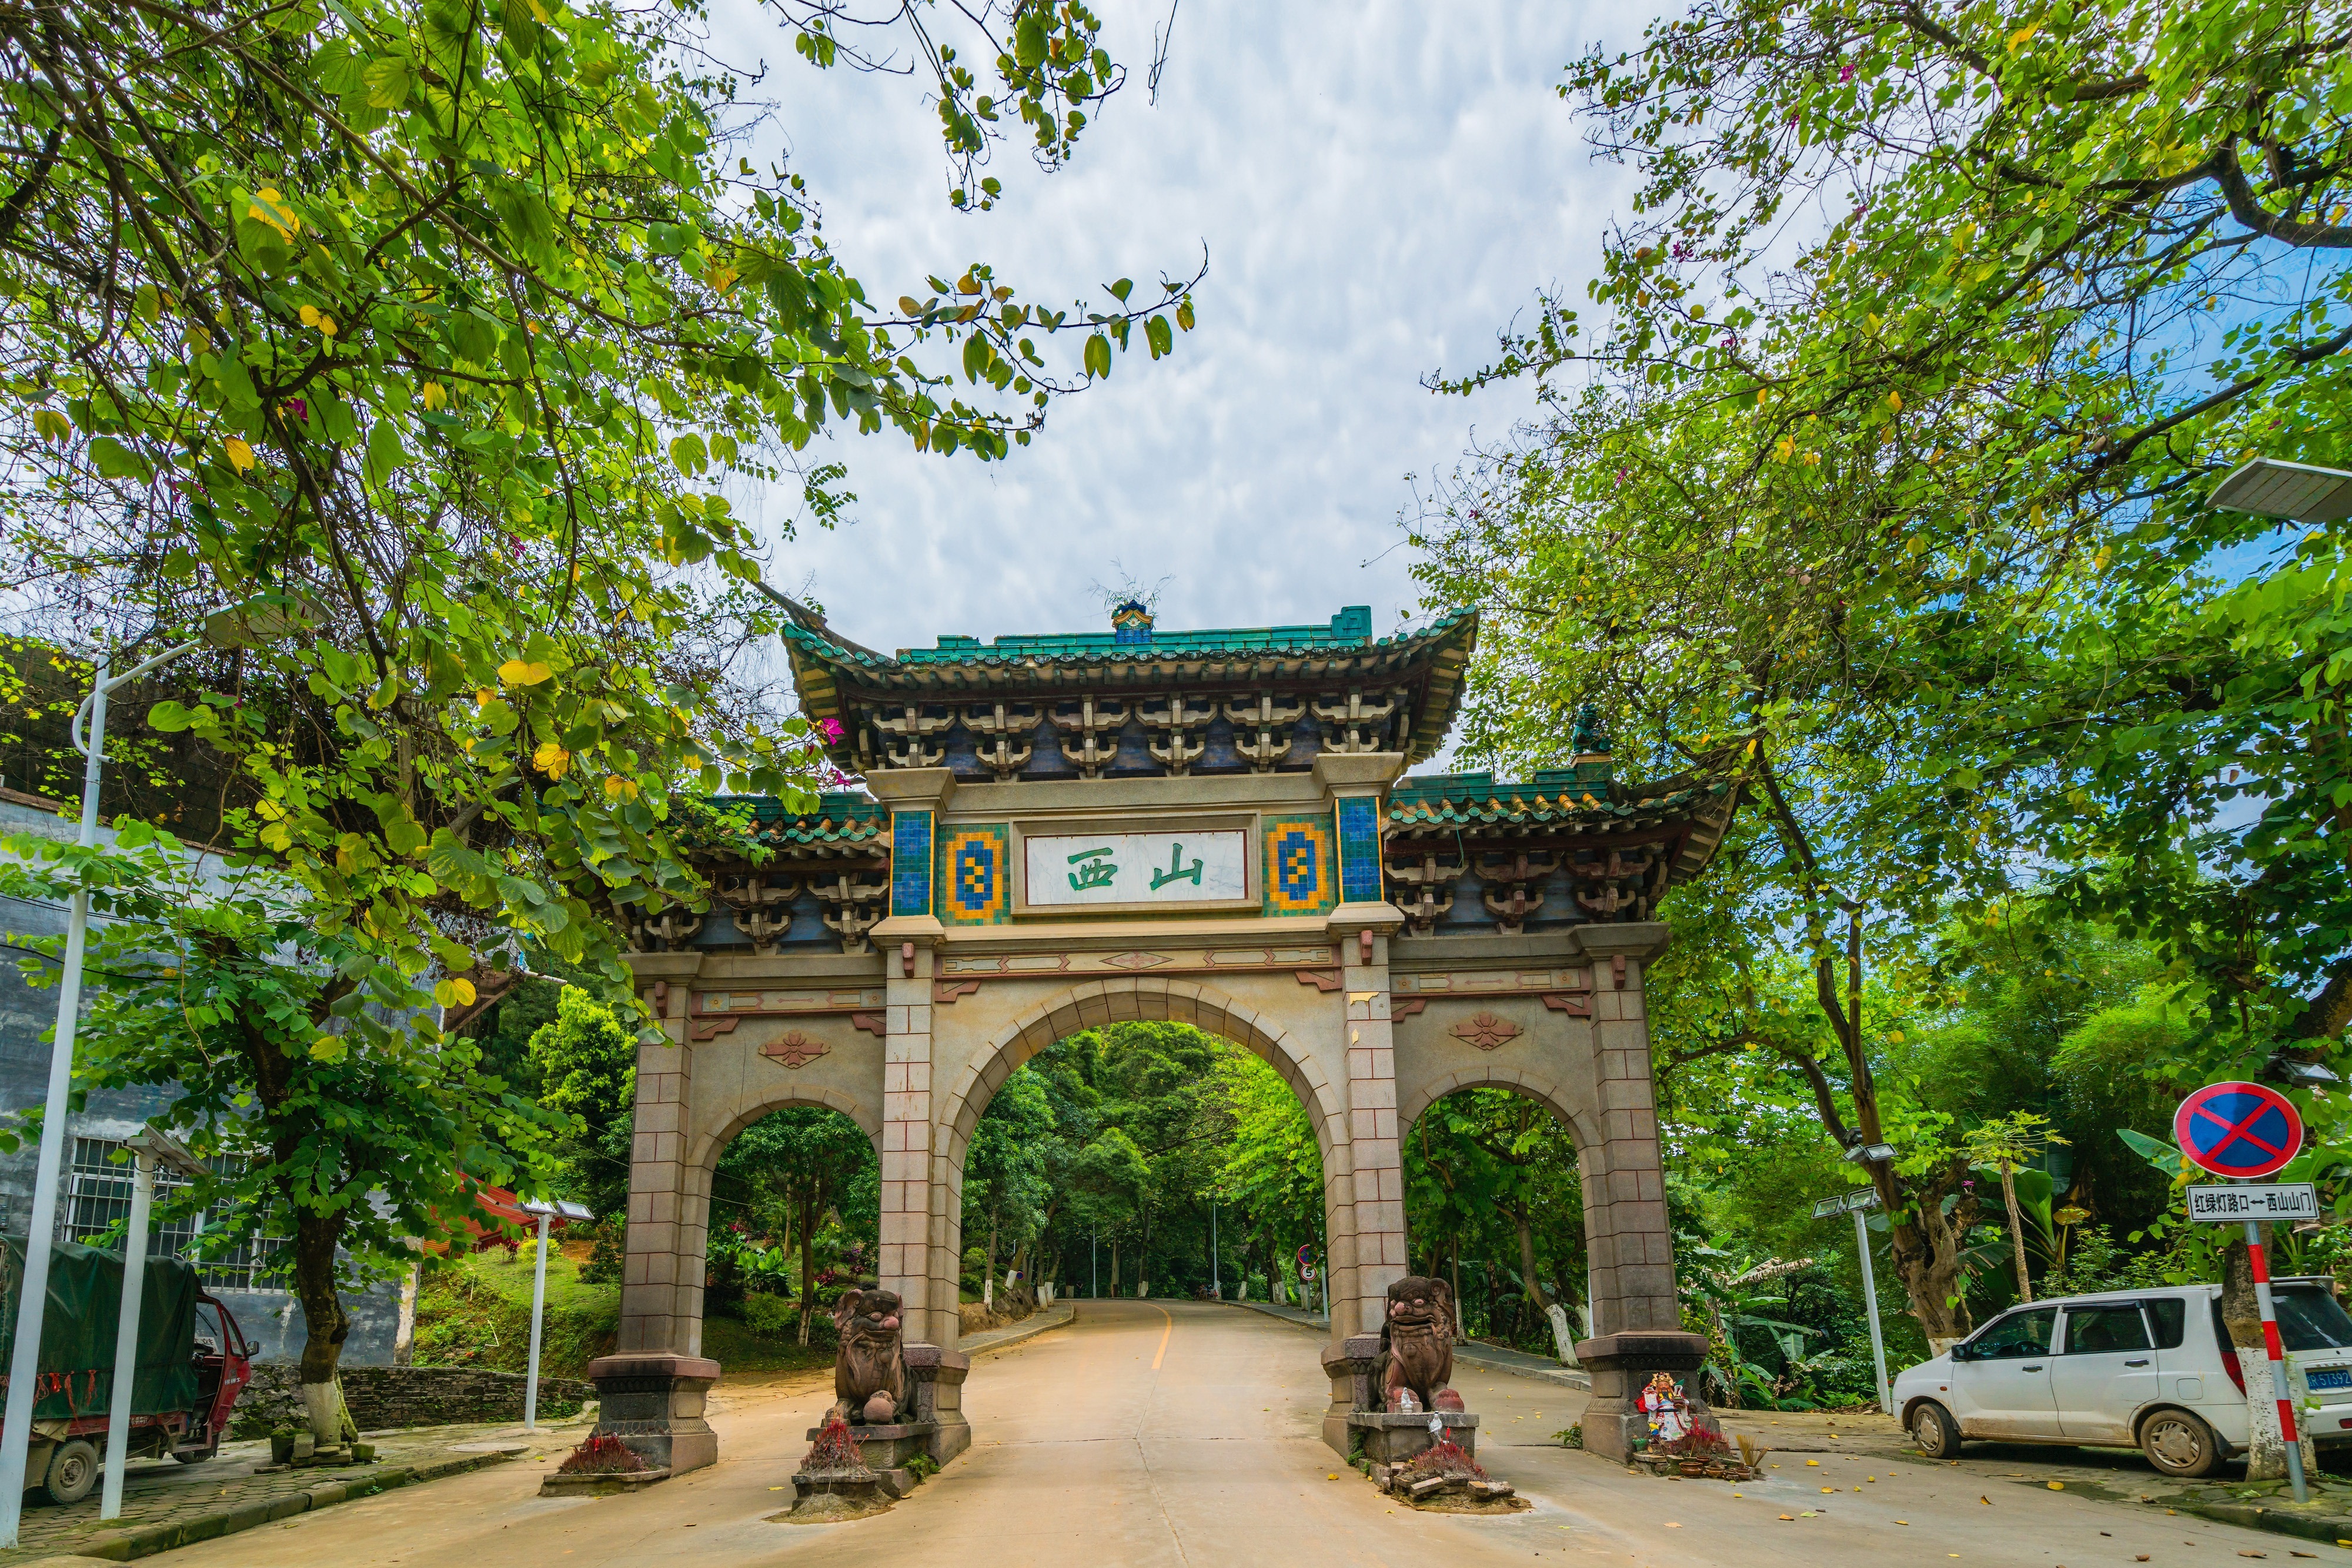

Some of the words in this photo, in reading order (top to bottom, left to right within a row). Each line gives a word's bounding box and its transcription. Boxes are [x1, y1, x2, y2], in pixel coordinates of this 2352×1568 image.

[1067, 843, 1203, 891] 西山
[2194, 1192, 2250, 1213] 红绿灯路口
[2265, 1192, 2311, 1212] 西山山门
[1306, 1268, 1312, 1277] 5
